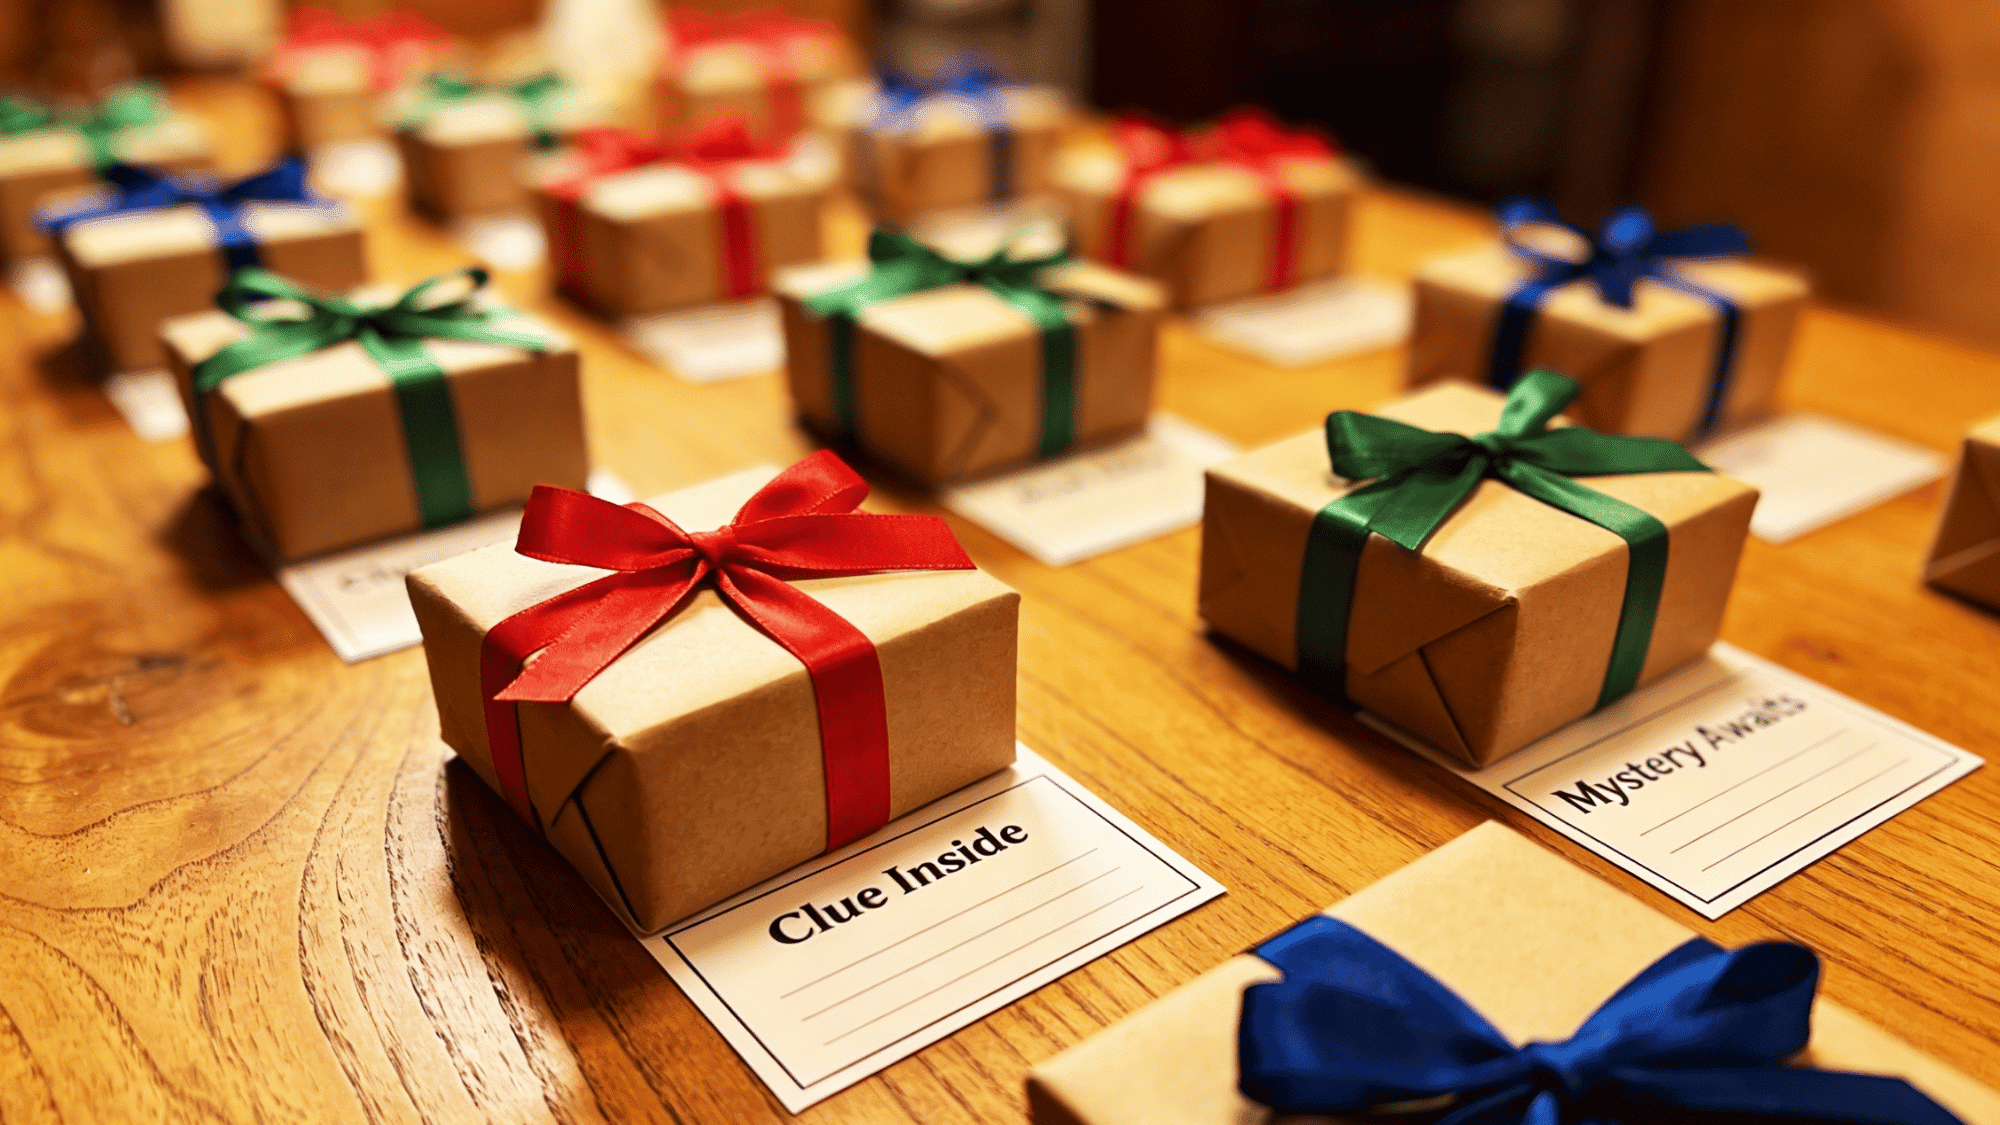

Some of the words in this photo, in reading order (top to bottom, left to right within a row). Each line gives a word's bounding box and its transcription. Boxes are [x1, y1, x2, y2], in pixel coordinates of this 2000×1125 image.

[1550, 740, 1706, 814] Mystery
[768, 887, 888, 944] Clue
[881, 824, 1029, 895] Inside
